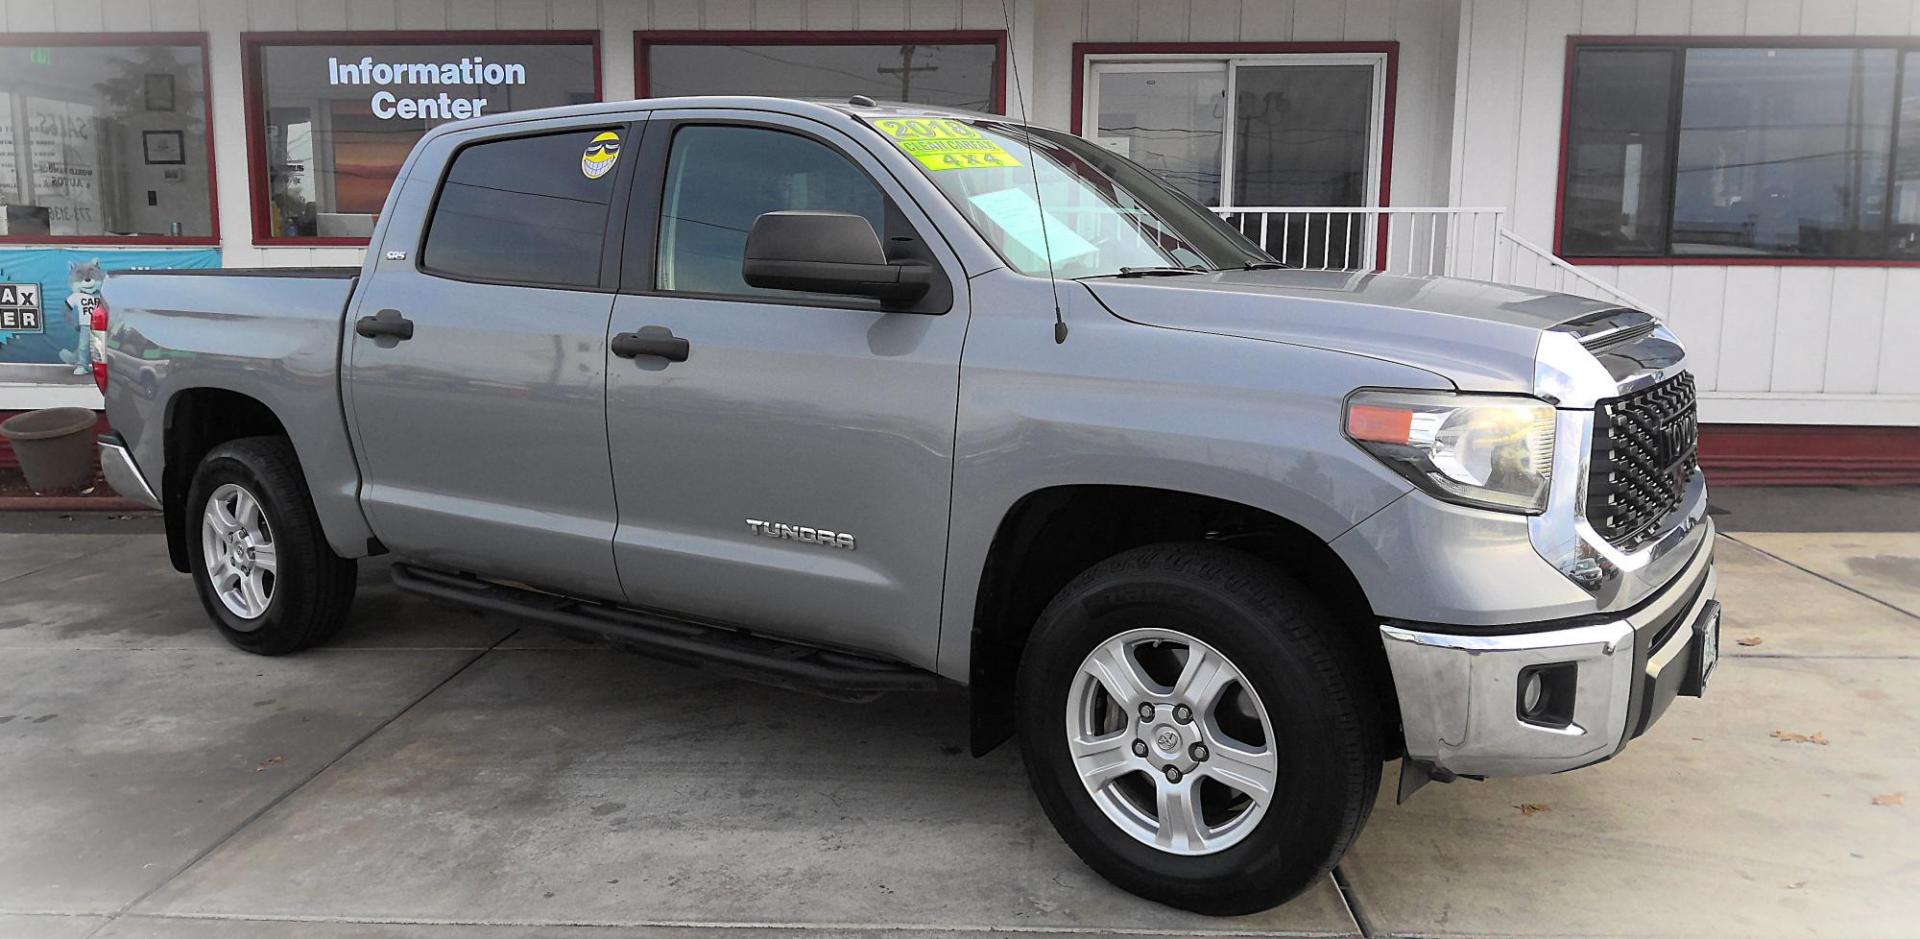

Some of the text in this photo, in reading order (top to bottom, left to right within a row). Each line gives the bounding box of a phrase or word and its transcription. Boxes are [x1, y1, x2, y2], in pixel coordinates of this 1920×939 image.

[327, 56, 526, 86] Information
[371, 91, 488, 120] Center
[903, 140, 947, 152] CLEAN
[82, 306, 94, 316] FO
[745, 518, 856, 550] TUNDRA
